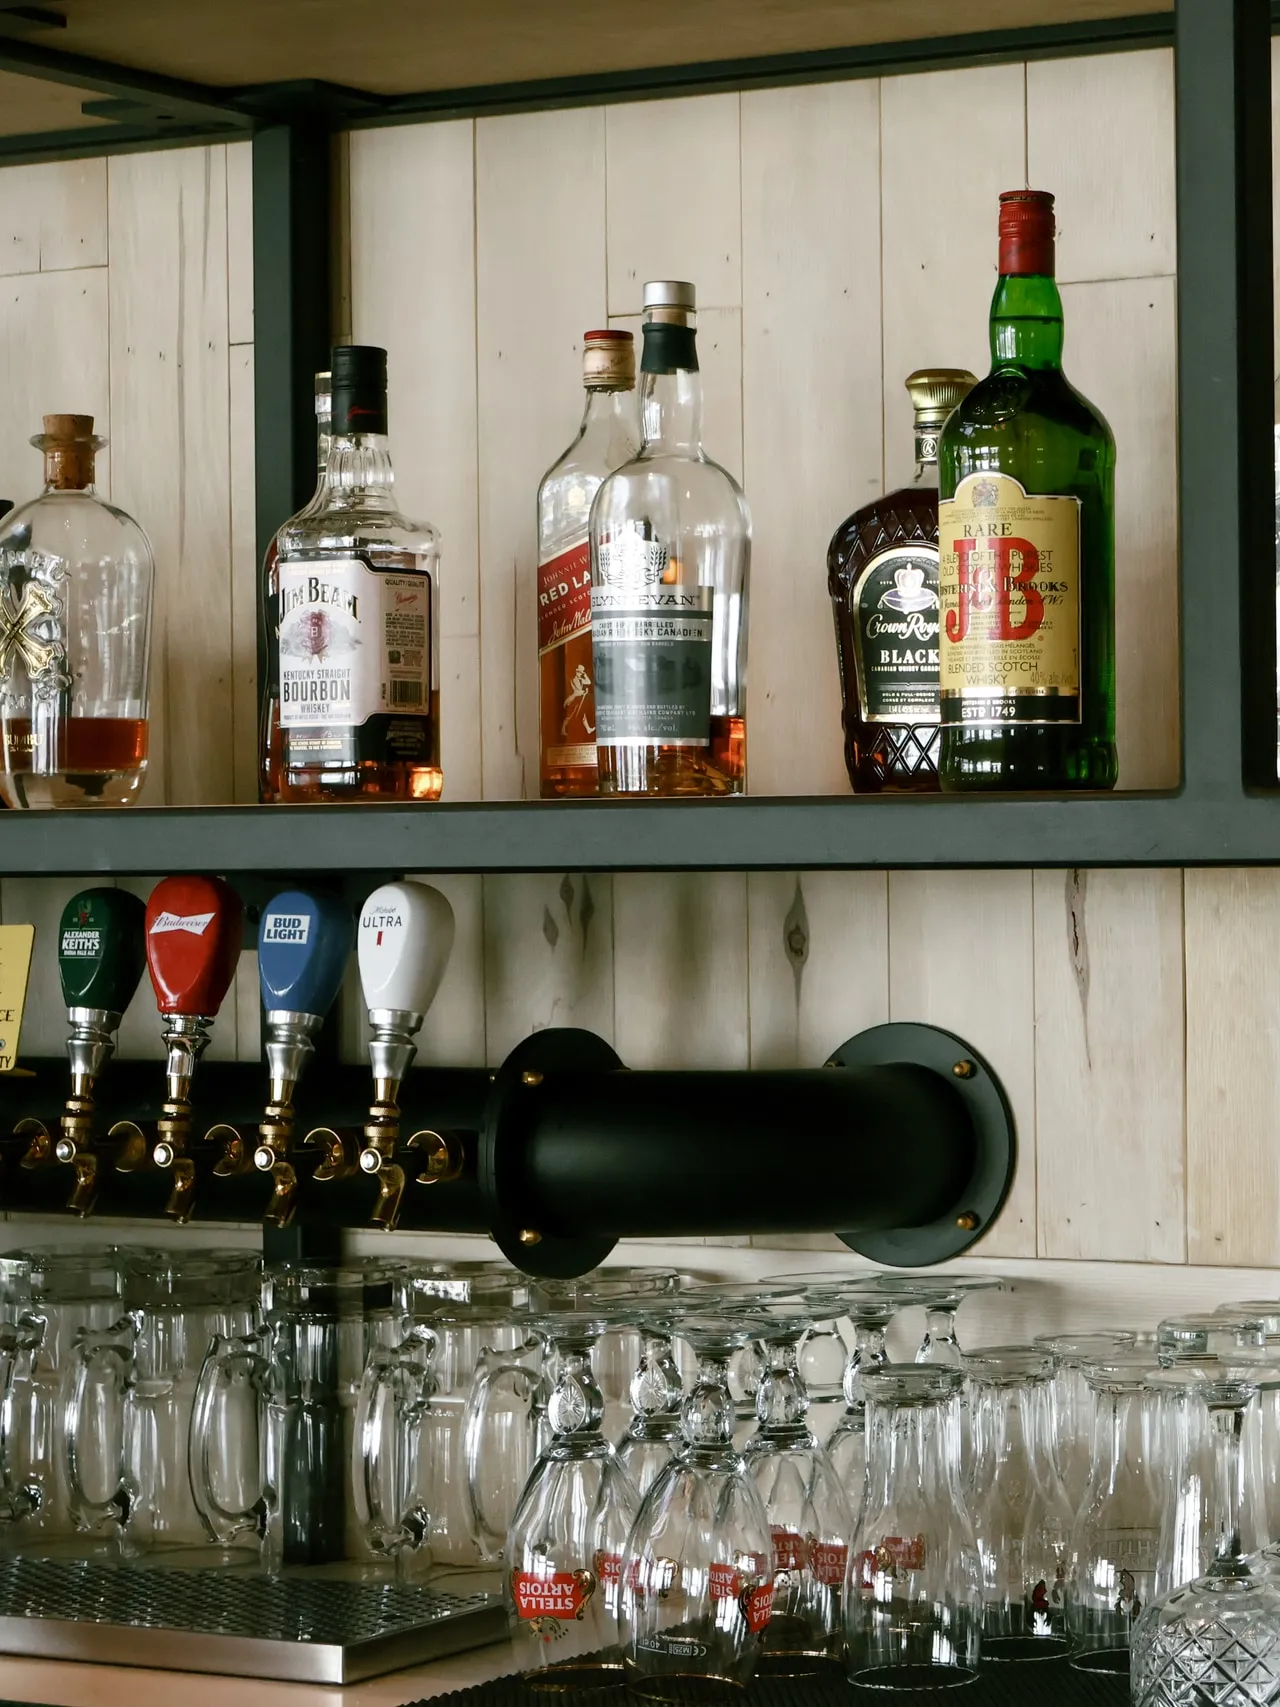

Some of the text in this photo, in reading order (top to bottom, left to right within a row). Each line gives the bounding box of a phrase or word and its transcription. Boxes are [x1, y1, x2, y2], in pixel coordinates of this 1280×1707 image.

[963, 523, 1013, 537] RARE
[1004, 576, 1068, 592] BROOKS
[307, 577, 358, 621] BEAM
[540, 582, 569, 607] RED
[866, 614, 908, 639] Crown
[880, 649, 940, 664] BLACK
[948, 661, 1038, 674] BLENDED SCOTCH
[284, 668, 351, 681] KENTUCKY STRAIGHT
[965, 673, 1008, 684] WHISKY
[283, 680, 351, 703] BOURBON
[300, 703, 330, 713] WHISKEY
[991, 706, 1016, 717] 1749
[155, 914, 208, 928] Budweiser
[273, 917, 302, 929] BUD
[362, 916, 403, 928] ULTRA
[63, 931, 100, 939] ALEXANDER
[266, 929, 306, 940] LIGHT
[62, 939, 100, 950] KEITH'S
[519, 1582, 575, 1595] ARTOIS
[520, 1597, 574, 1610] STELLA
